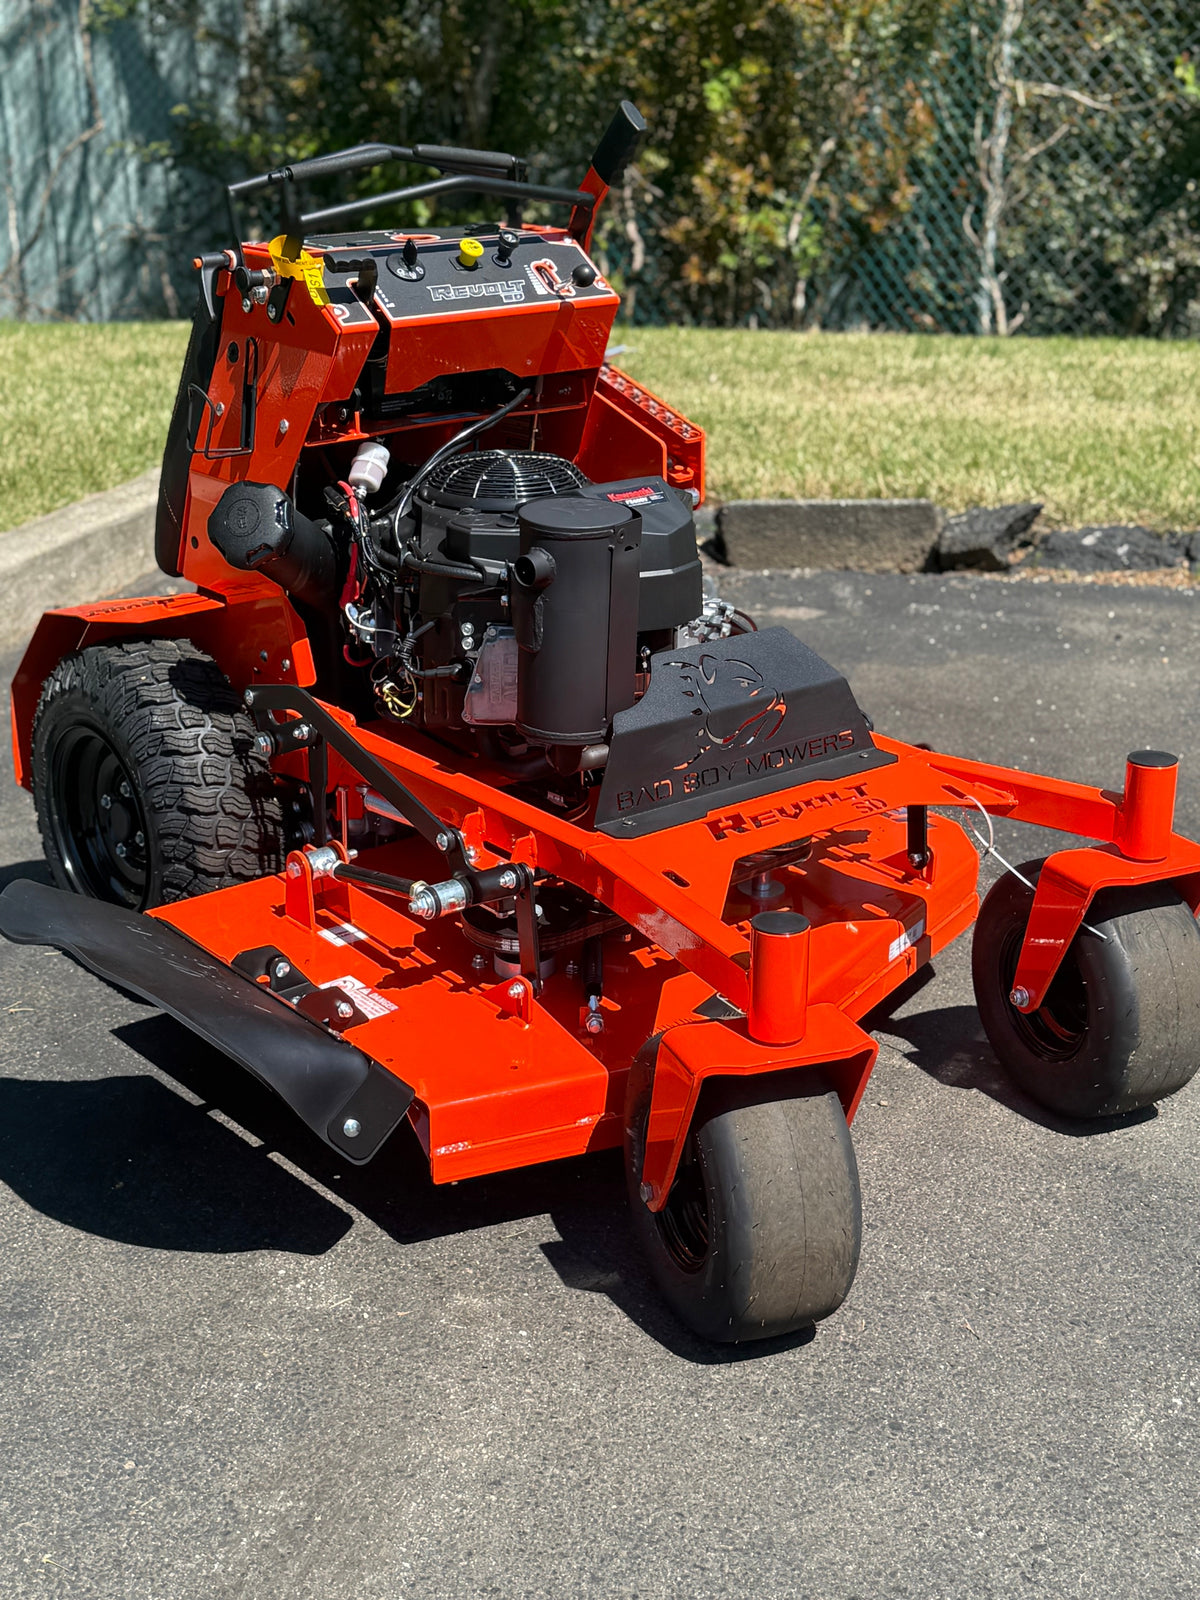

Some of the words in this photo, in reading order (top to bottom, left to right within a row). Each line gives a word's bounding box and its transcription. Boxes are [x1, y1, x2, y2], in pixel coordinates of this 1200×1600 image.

[426, 280, 526, 302] REVOLT
[616, 779, 674, 812] BAD
[683, 762, 738, 794] BOY
[744, 729, 855, 775] MOWERS
[703, 781, 869, 842] REVOLT
